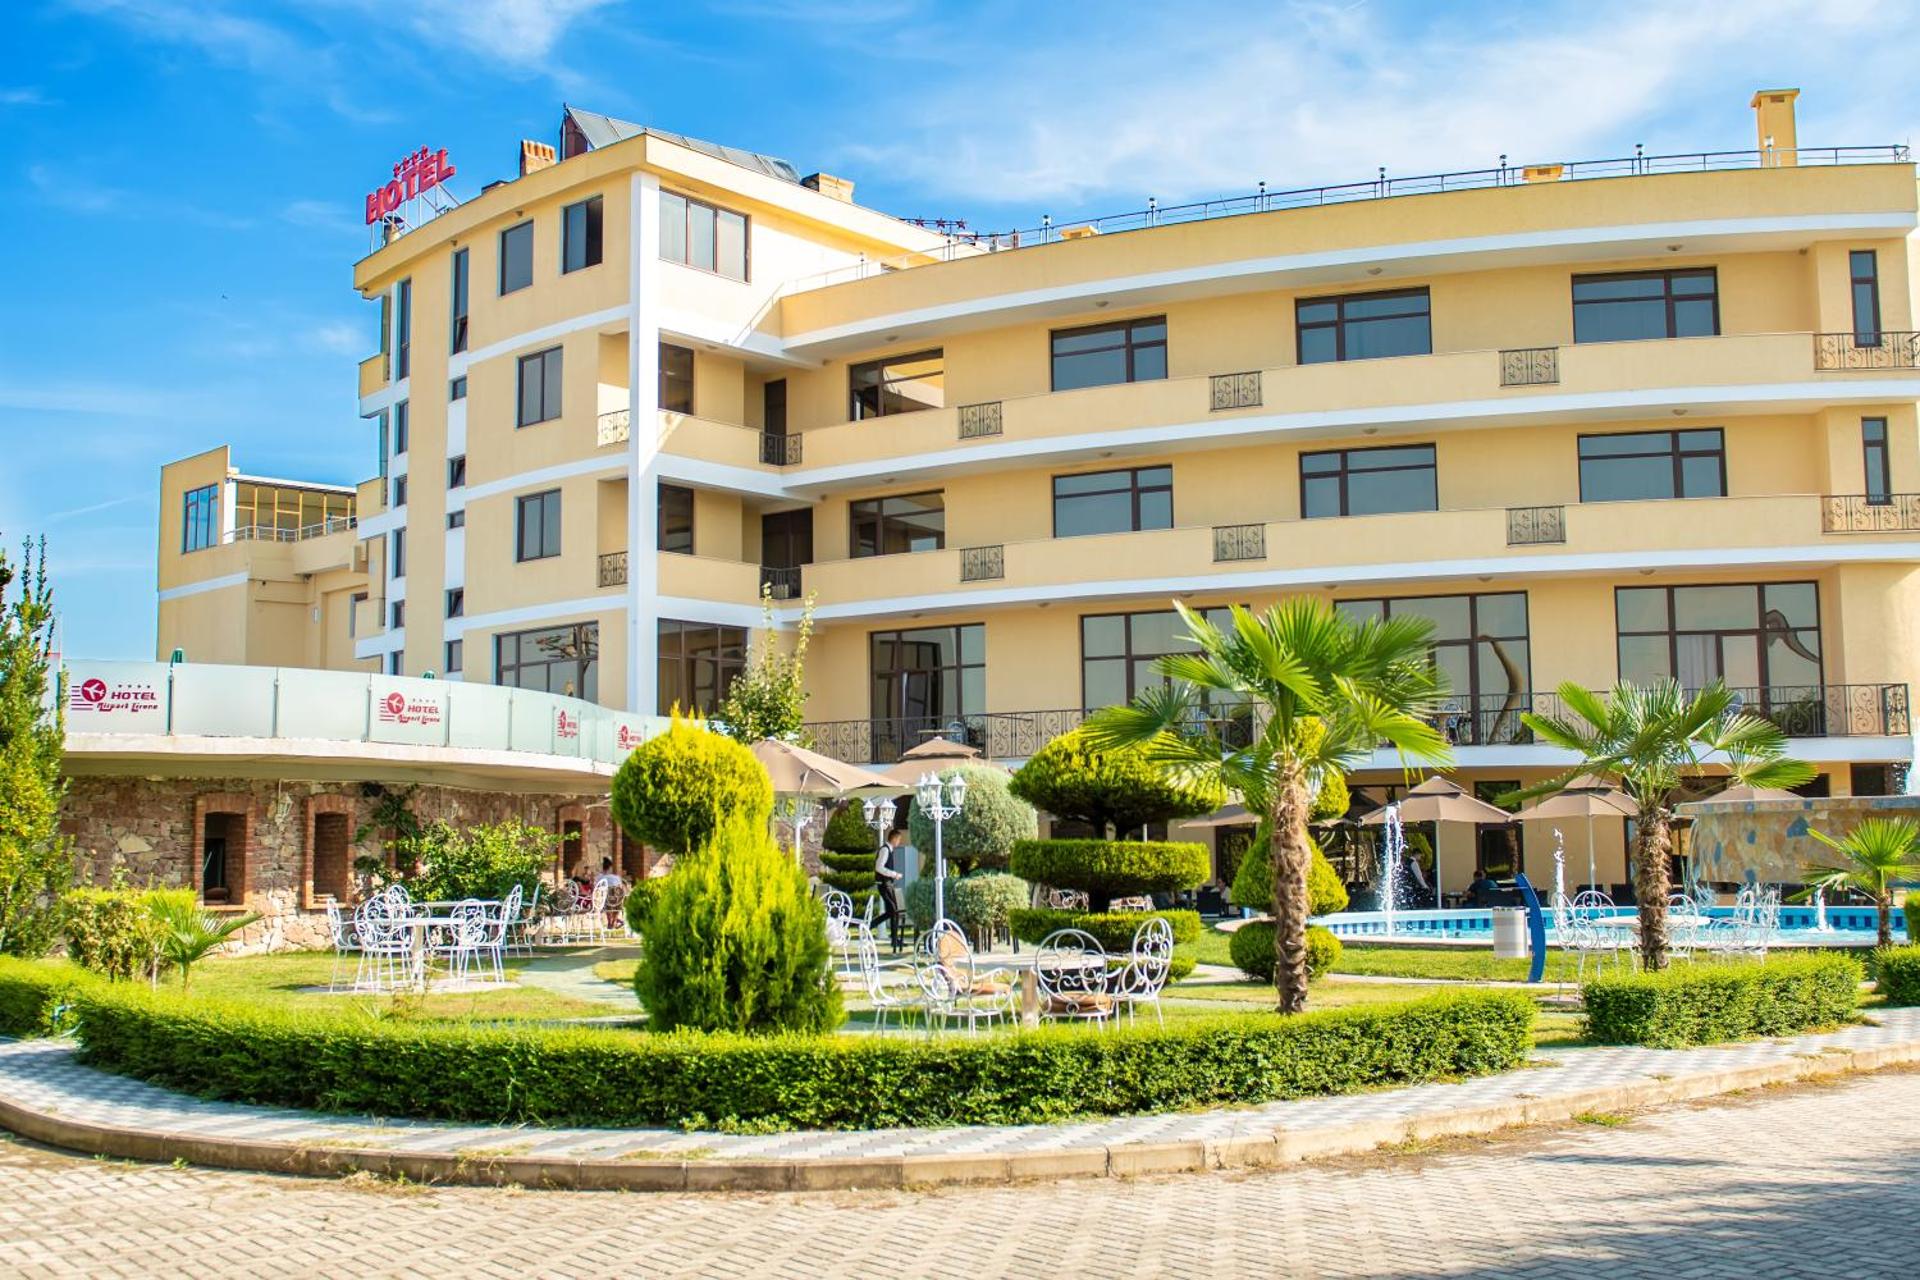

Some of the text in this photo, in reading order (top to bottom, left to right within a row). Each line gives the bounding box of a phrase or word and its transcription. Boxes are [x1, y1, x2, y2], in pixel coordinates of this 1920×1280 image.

[365, 147, 456, 225] HOTEL
[111, 691, 156, 701] HOTEL
[407, 705, 439, 714] HOTEL
